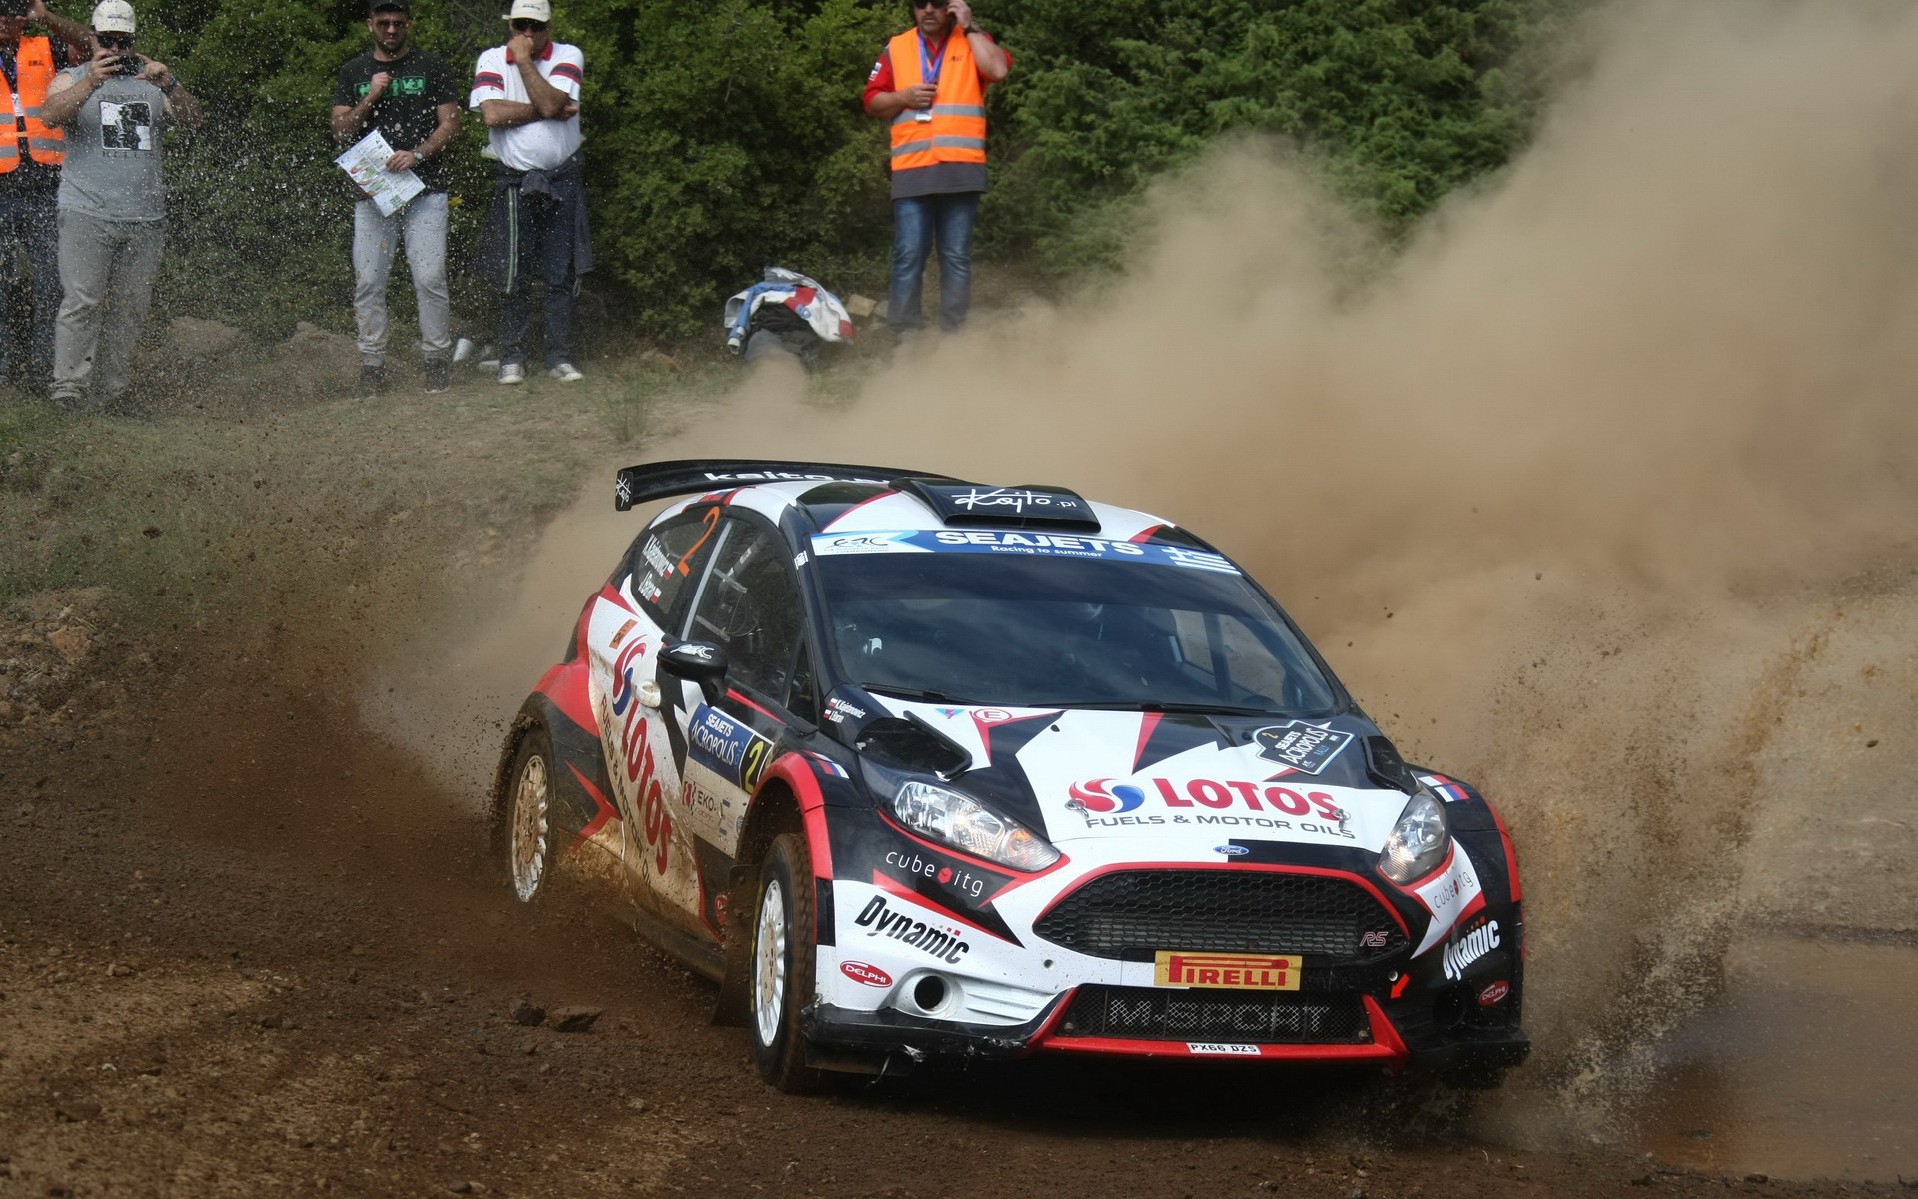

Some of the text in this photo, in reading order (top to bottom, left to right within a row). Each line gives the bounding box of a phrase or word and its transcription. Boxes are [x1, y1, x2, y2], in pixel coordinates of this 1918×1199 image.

[677, 506, 721, 577] 2
[936, 531, 1145, 556] SEAJETS
[991, 545, 1035, 555] Racing
[1054, 549, 1102, 558] summer
[706, 713, 734, 738] SEAJETS
[690, 719, 739, 766] ACROPOLIS
[1278, 727, 1329, 765] ACROPOLIS
[745, 740, 765, 795] 2
[622, 695, 672, 876] LOTOS
[1152, 778, 1342, 822] LOTOS
[1085, 814, 1356, 839] FUELS & MOTOR OILS
[885, 851, 984, 897] cube itg
[1433, 884, 1455, 909] cube
[854, 894, 970, 964] Dynamic
[1360, 931, 1389, 946] RS
[845, 964, 887, 984] DELPHI
[1169, 955, 1290, 987] PIRELLI
[1109, 999, 1331, 1032] M-SPORT
[1190, 1044, 1226, 1053] PX66
